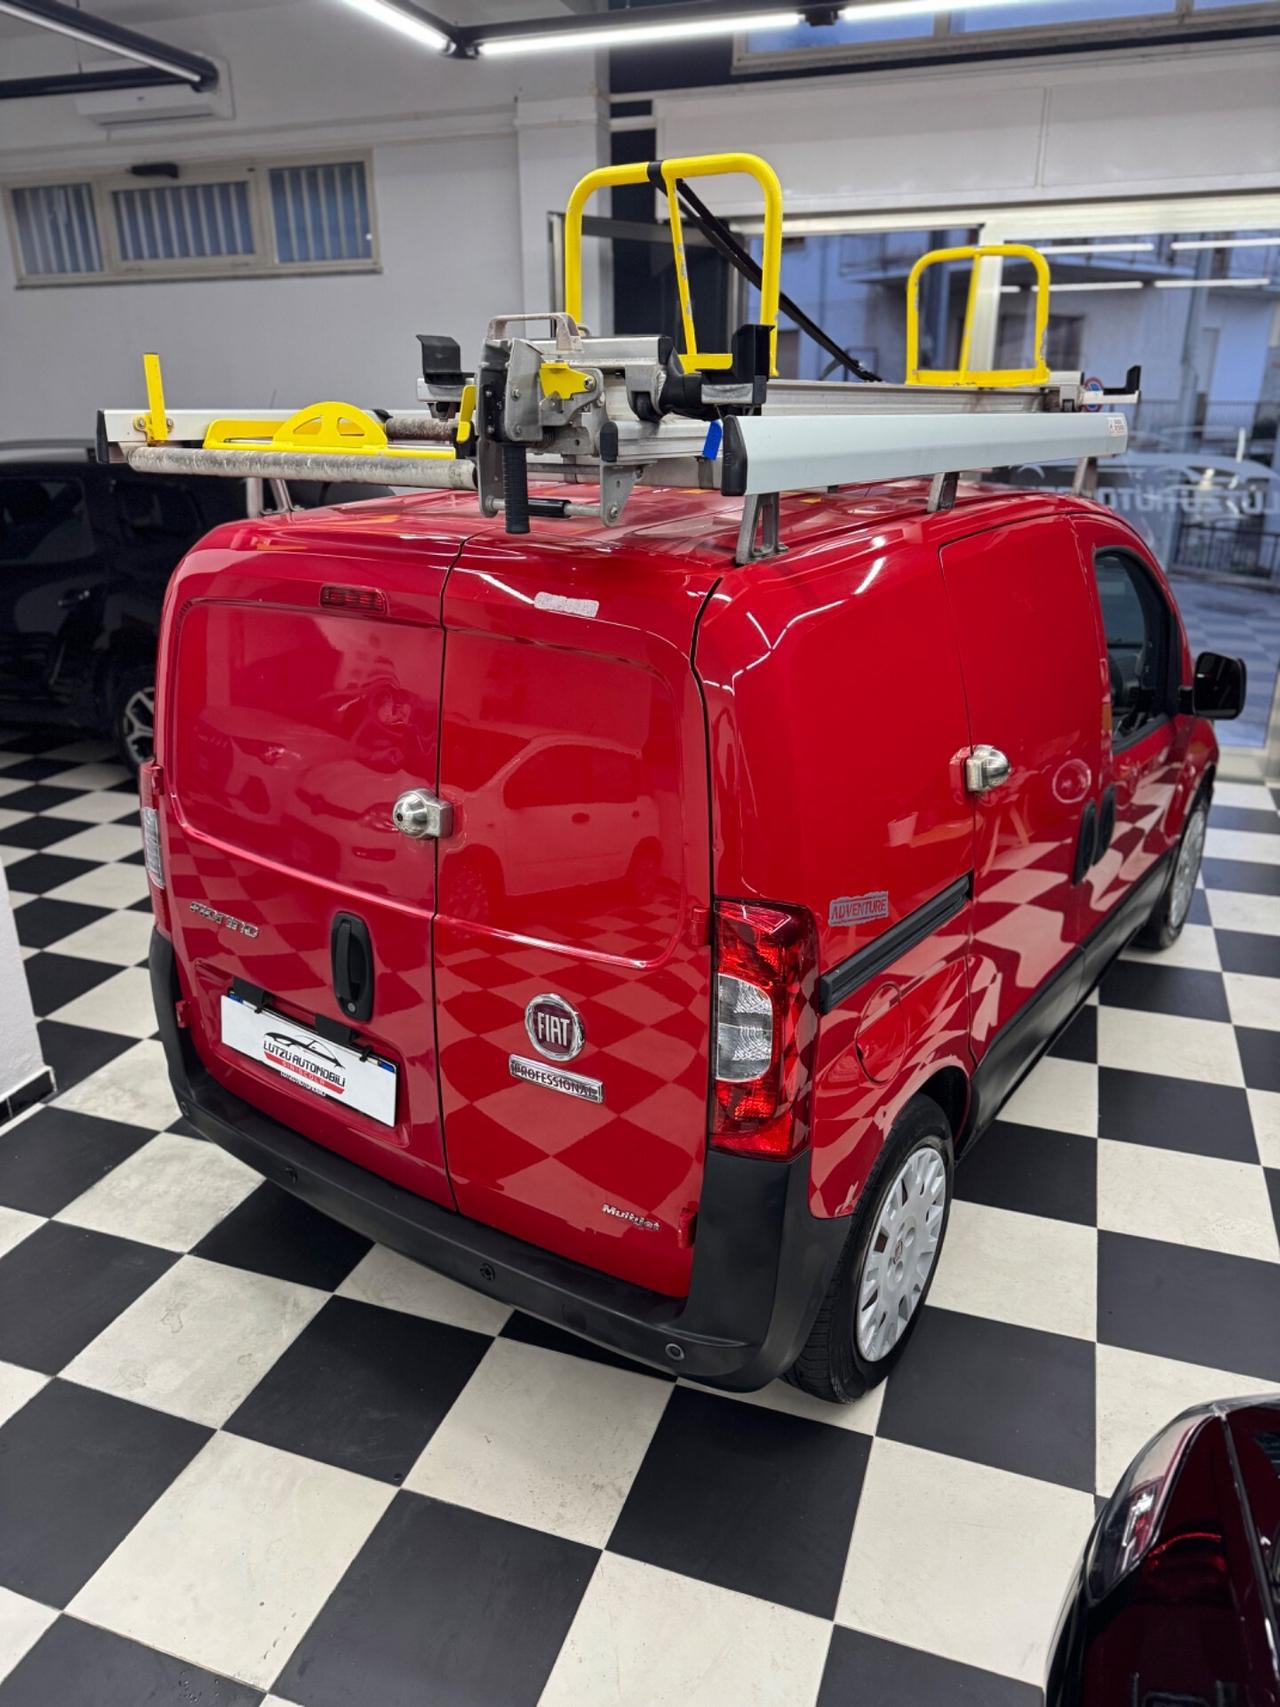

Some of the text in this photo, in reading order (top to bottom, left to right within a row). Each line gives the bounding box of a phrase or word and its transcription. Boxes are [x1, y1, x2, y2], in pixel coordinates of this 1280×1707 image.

[831, 898, 887, 920] ADVENTURE
[537, 1012, 571, 1047] FIAT
[263, 1040, 292, 1062] LUTZU
[513, 1061, 597, 1098] PROFESSIONAL
